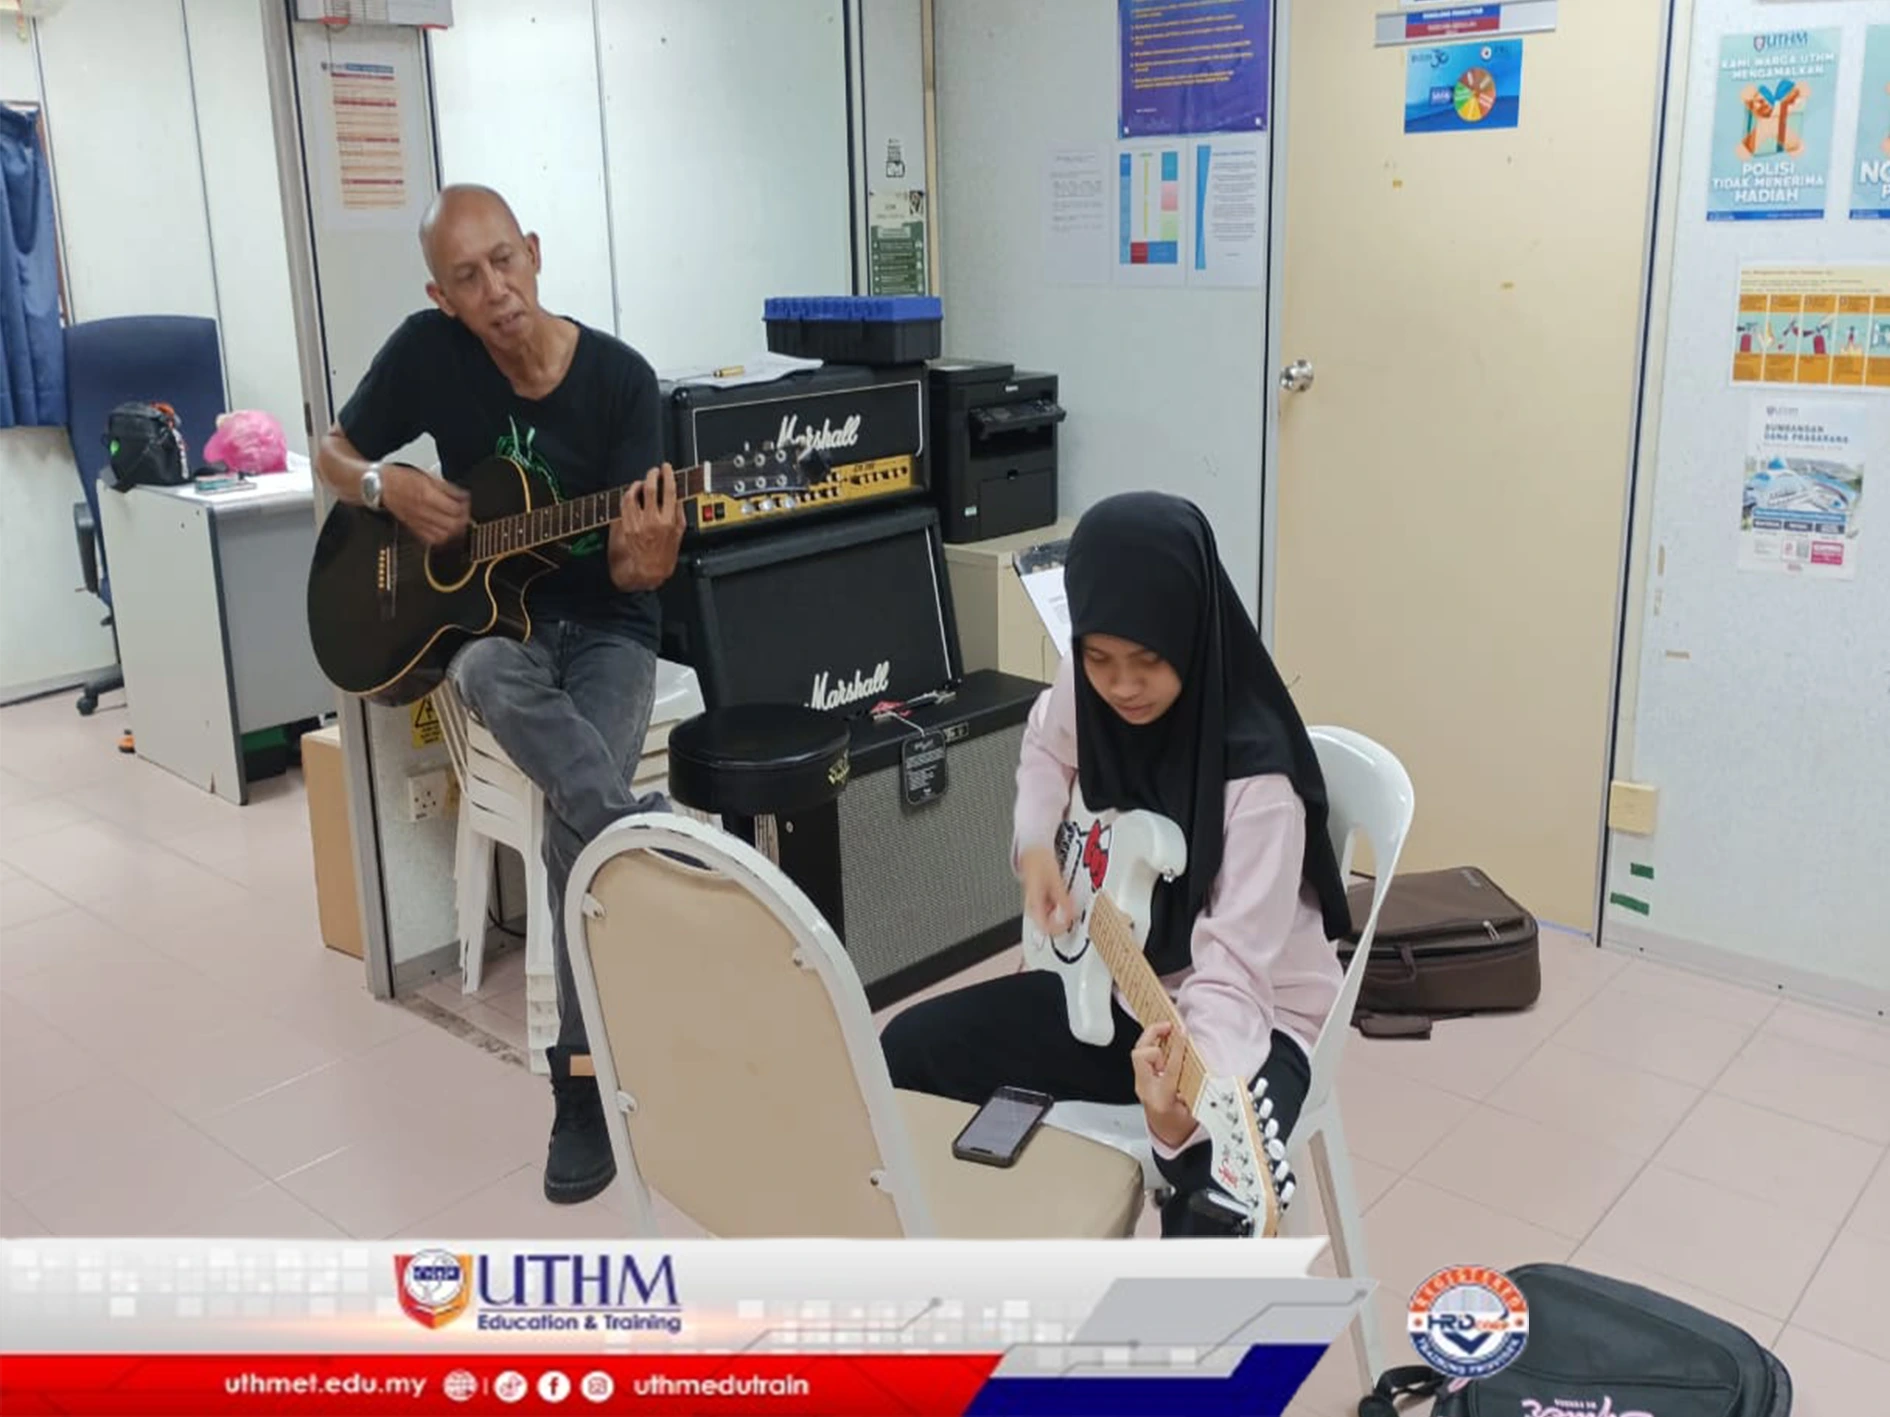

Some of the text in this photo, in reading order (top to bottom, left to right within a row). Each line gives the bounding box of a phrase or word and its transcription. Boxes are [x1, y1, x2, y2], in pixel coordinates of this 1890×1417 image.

[1755, 55, 1796, 66] WARGA
[1801, 52, 1834, 63] UTHM
[1732, 65, 1824, 78] MENGAMALKAN
[1742, 161, 1795, 175] POLISI
[1713, 175, 1824, 189] TIDAK MENERIMA
[1734, 188, 1799, 202] HADIAH
[776, 414, 861, 451] Marshall
[806, 660, 890, 711] Marshall
